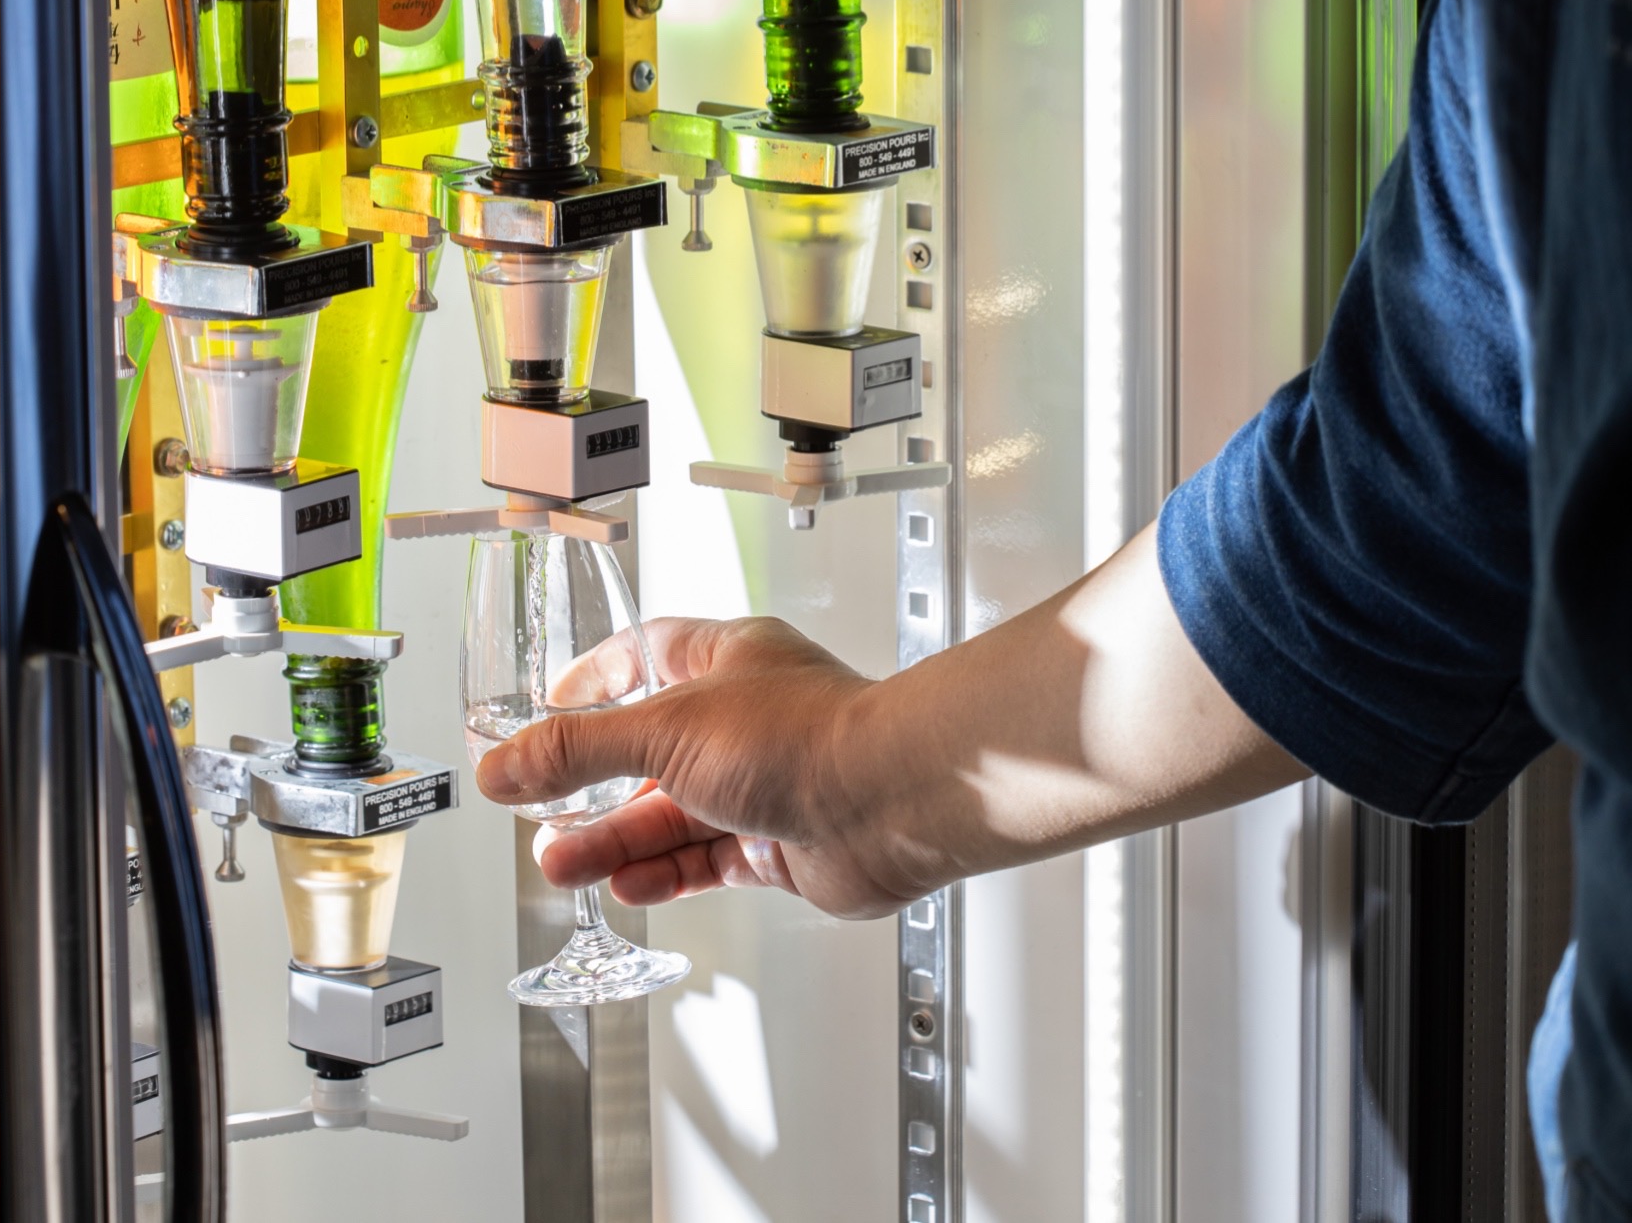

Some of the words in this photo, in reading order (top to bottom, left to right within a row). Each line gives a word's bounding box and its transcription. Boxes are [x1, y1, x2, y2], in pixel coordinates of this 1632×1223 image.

[845, 140, 888, 157] PRECISION
[889, 133, 917, 149] POURS
[918, 132, 929, 142] Inc
[859, 156, 873, 167] 800
[878, 152, 893, 163] 549
[897, 146, 916, 158] 4491
[858, 167, 877, 178] MADE
[878, 165, 885, 175] IN
[886, 159, 916, 173] ENGLAND
[365, 785, 408, 807] PRECISION
[409, 777, 437, 794] POURS
[438, 775, 449, 785] Inc
[378, 802, 393, 815] 800
[399, 796, 413, 809] 549
[418, 789, 435, 802] 4491
[378, 814, 398, 825] MADE
[398, 812, 405, 820] IN
[406, 802, 437, 817] ENGLAND
